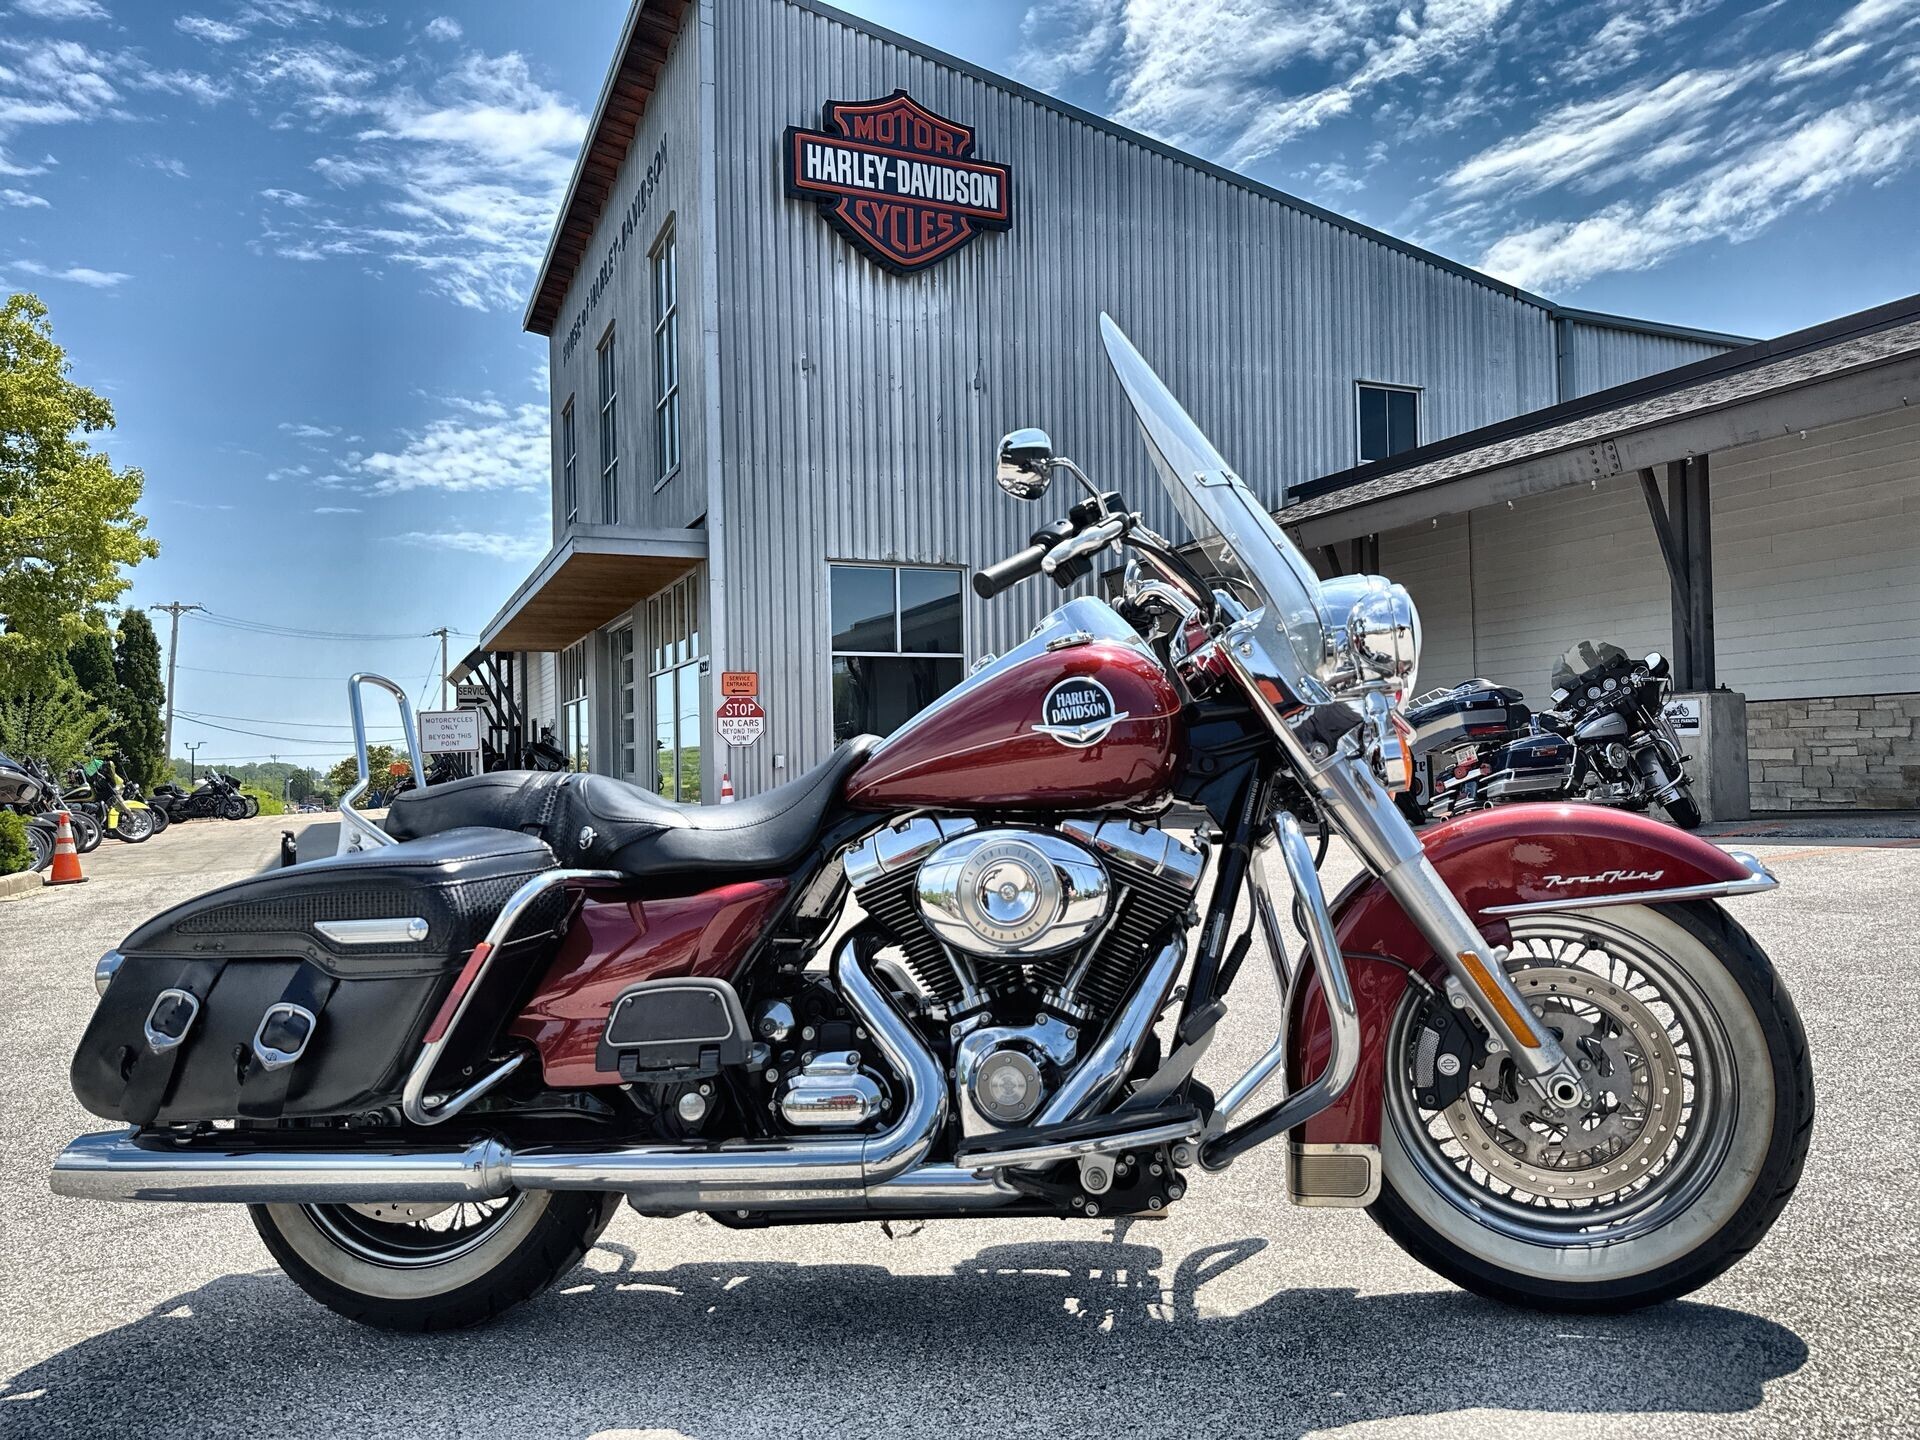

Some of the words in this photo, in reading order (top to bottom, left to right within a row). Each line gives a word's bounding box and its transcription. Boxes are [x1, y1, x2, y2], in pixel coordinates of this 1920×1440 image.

[853, 107, 954, 156] MOTOR
[806, 143, 998, 210] HARLEY-DAVIDSON
[855, 200, 954, 254] CYCLES
[725, 703, 756, 716] STOP
[1056, 689, 1101, 708] HARLEY-
[722, 719, 734, 727] NO
[737, 719, 760, 727] CARS
[1051, 702, 1106, 724] DAVIDSON
